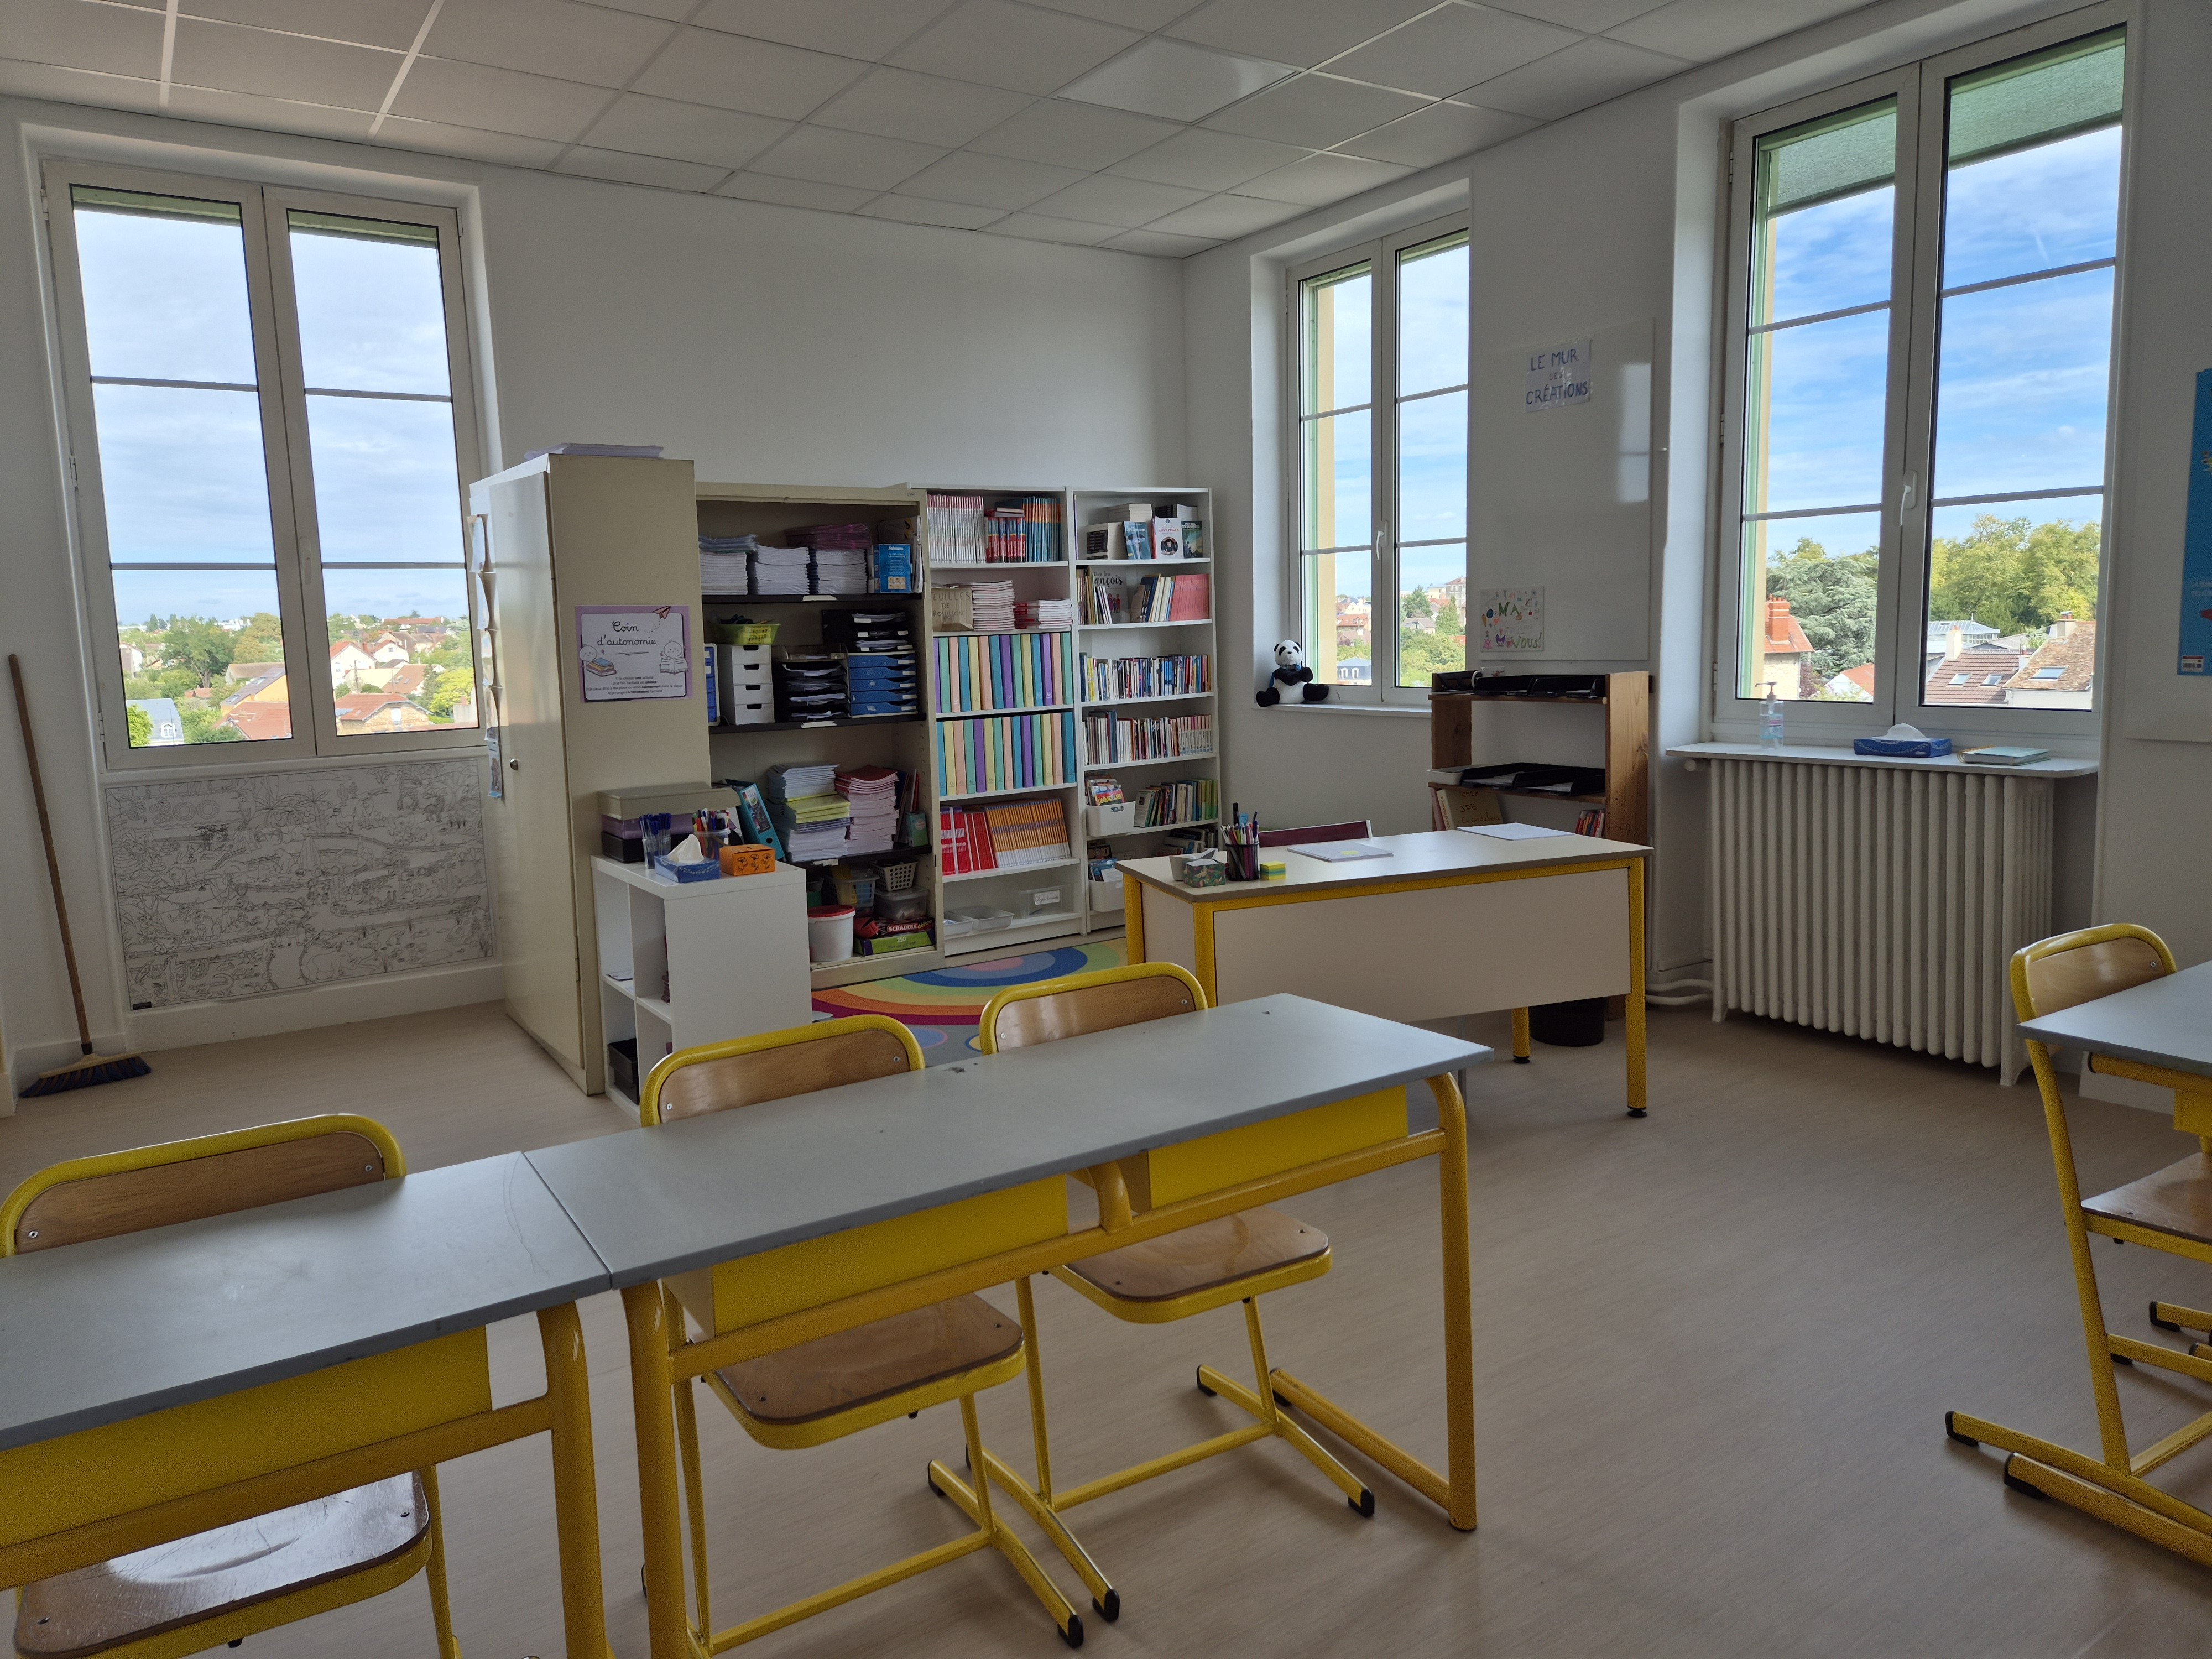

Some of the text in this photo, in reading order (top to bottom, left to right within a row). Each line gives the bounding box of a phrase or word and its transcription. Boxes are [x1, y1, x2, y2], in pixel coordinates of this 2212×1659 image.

[1530, 348, 1580, 371] LE MUR
[1549, 371, 1563, 380] DES
[1526, 380, 1589, 405] CRÉATIONS
[1094, 575, 1123, 587] ançois
[931, 592, 971, 601] EUILLES
[933, 609, 964, 618] ROUILLON
[612, 620, 639, 632] Coin
[597, 634, 656, 646] d'autonomie
[1459, 803, 1478, 812] JDB
[888, 924, 918, 932] SCRABBLE
